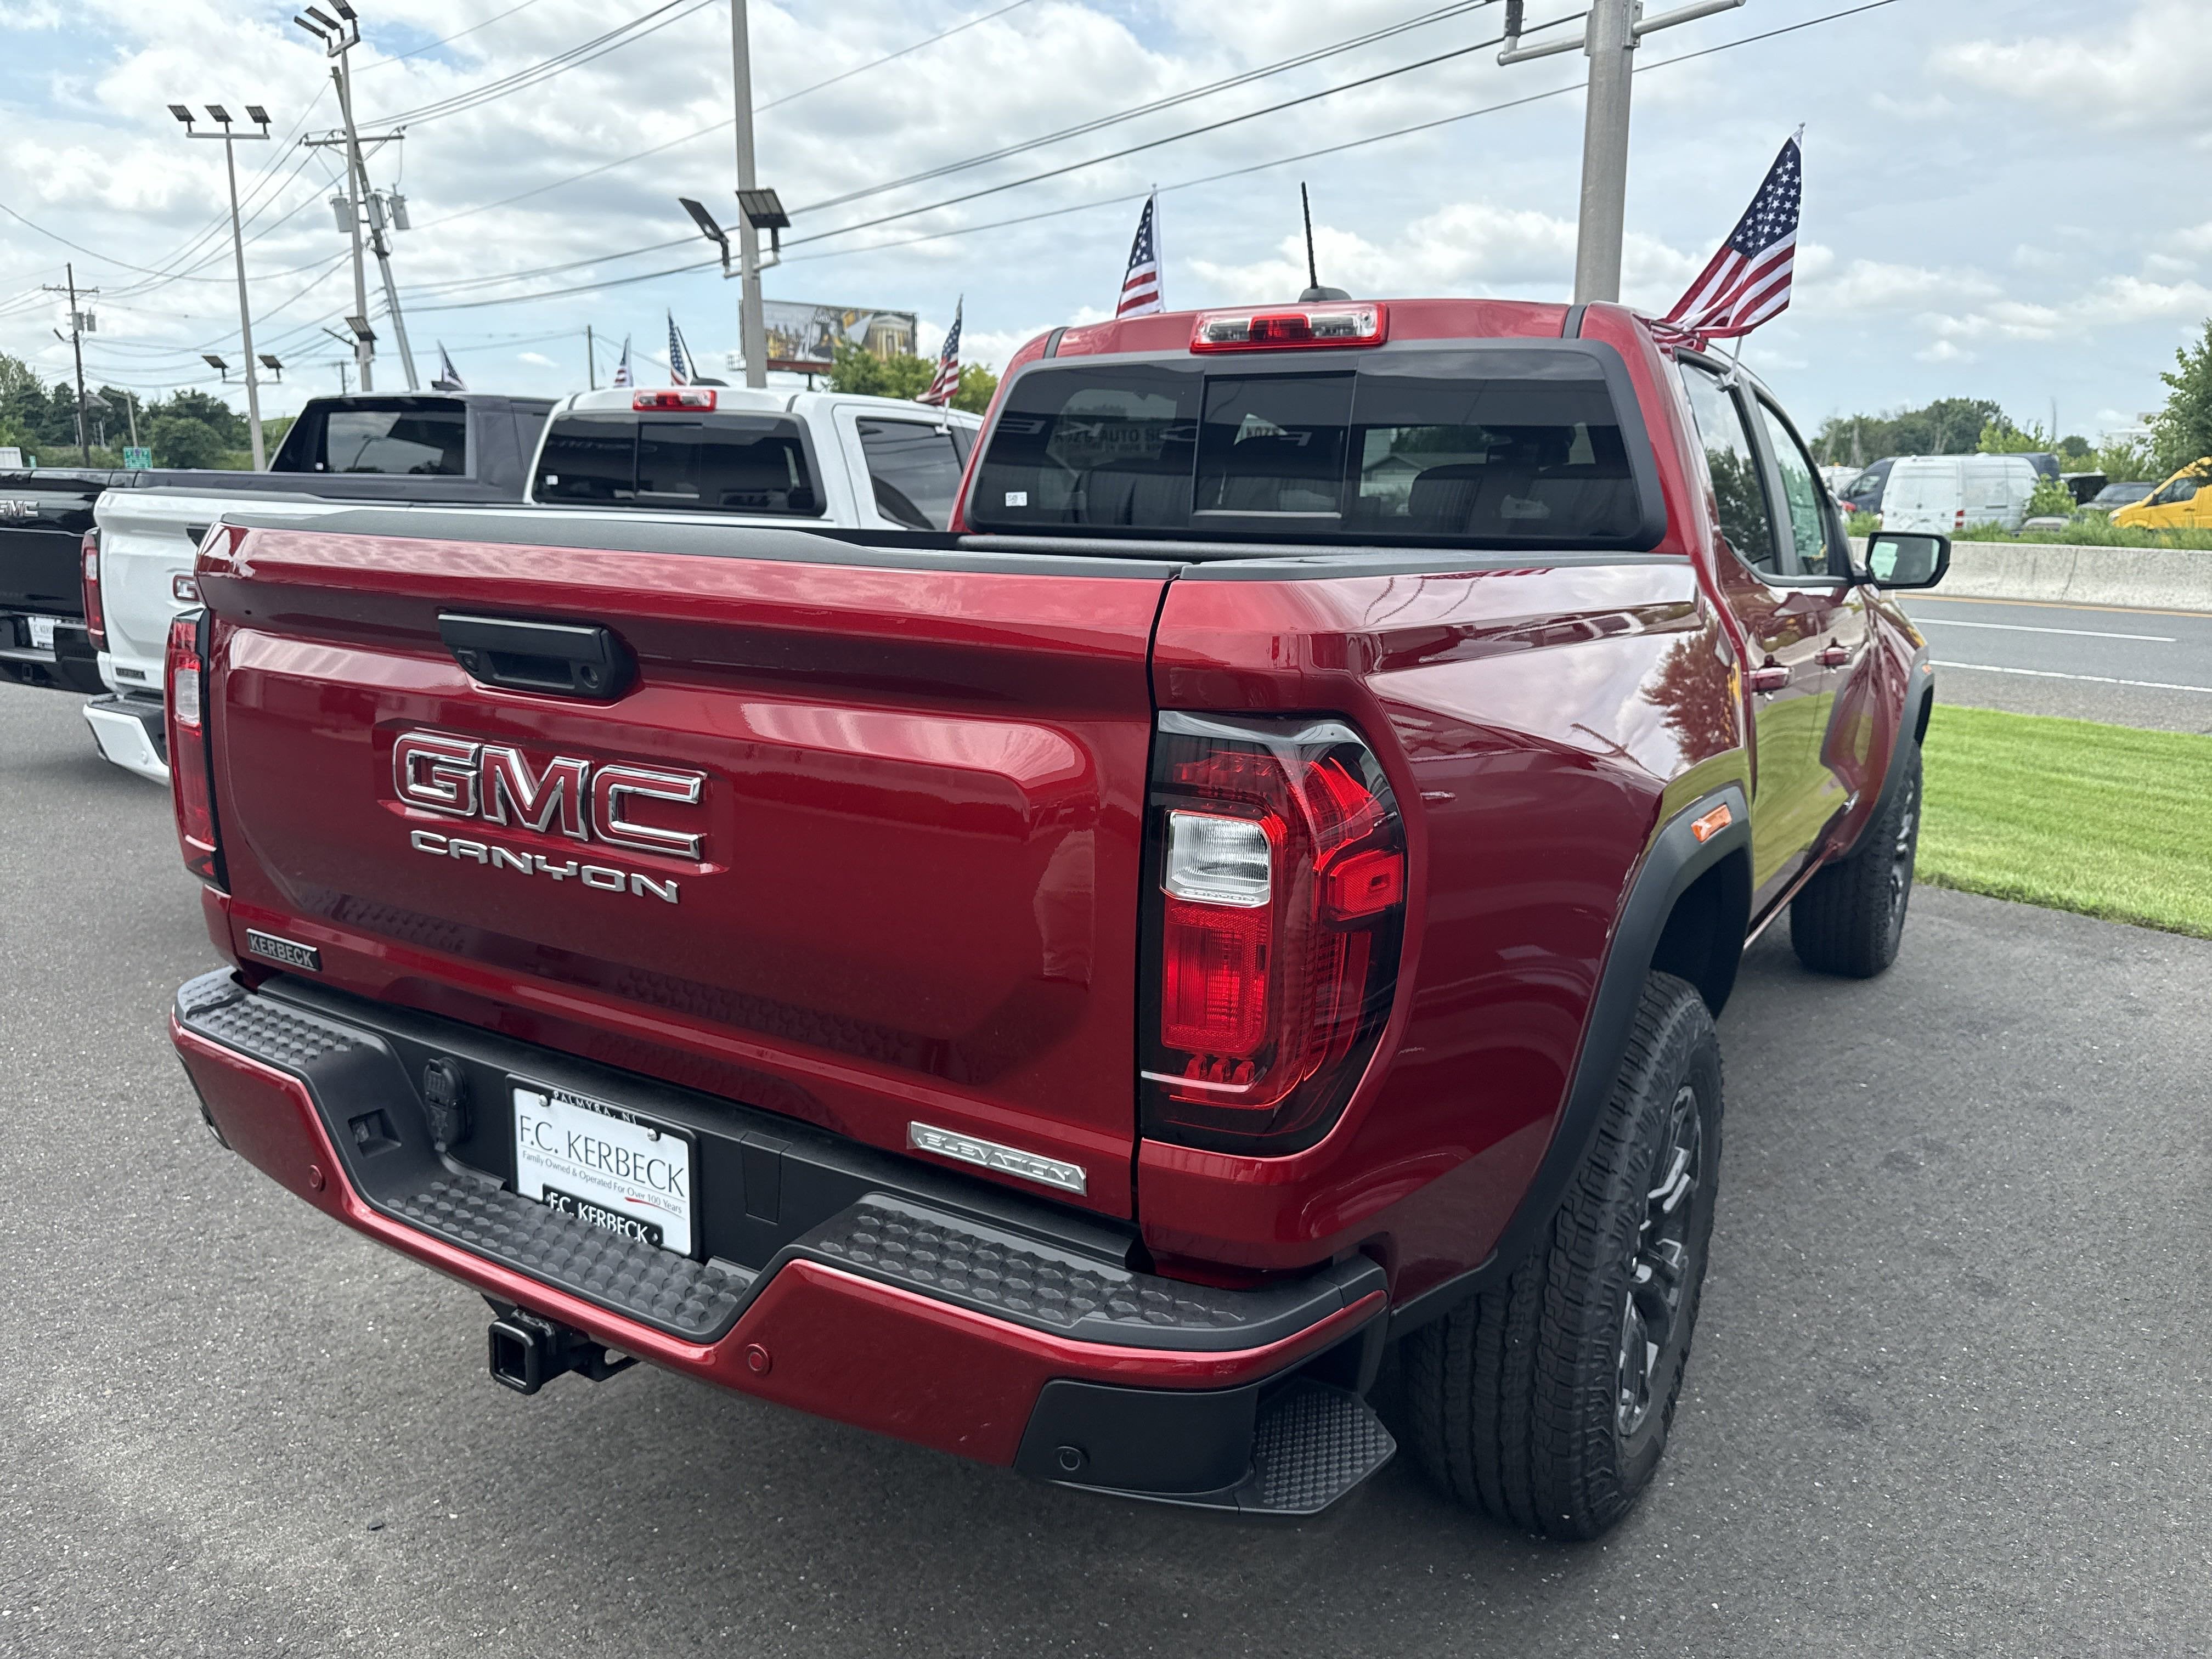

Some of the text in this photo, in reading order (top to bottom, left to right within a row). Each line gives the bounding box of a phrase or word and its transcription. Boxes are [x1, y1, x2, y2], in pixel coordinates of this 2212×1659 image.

[392, 732, 703, 860] GMC
[410, 830, 679, 904] CANYON
[250, 934, 314, 968] KERBECK
[553, 1090, 616, 1120] PALMYRA,
[520, 1114, 685, 1198] F.C. KERBECK
[523, 1150, 682, 1214] Family Owned & Operated For Over 100 Years
[923, 1132, 1073, 1181] ELEVATION
[578, 1202, 648, 1244] KERBECK
